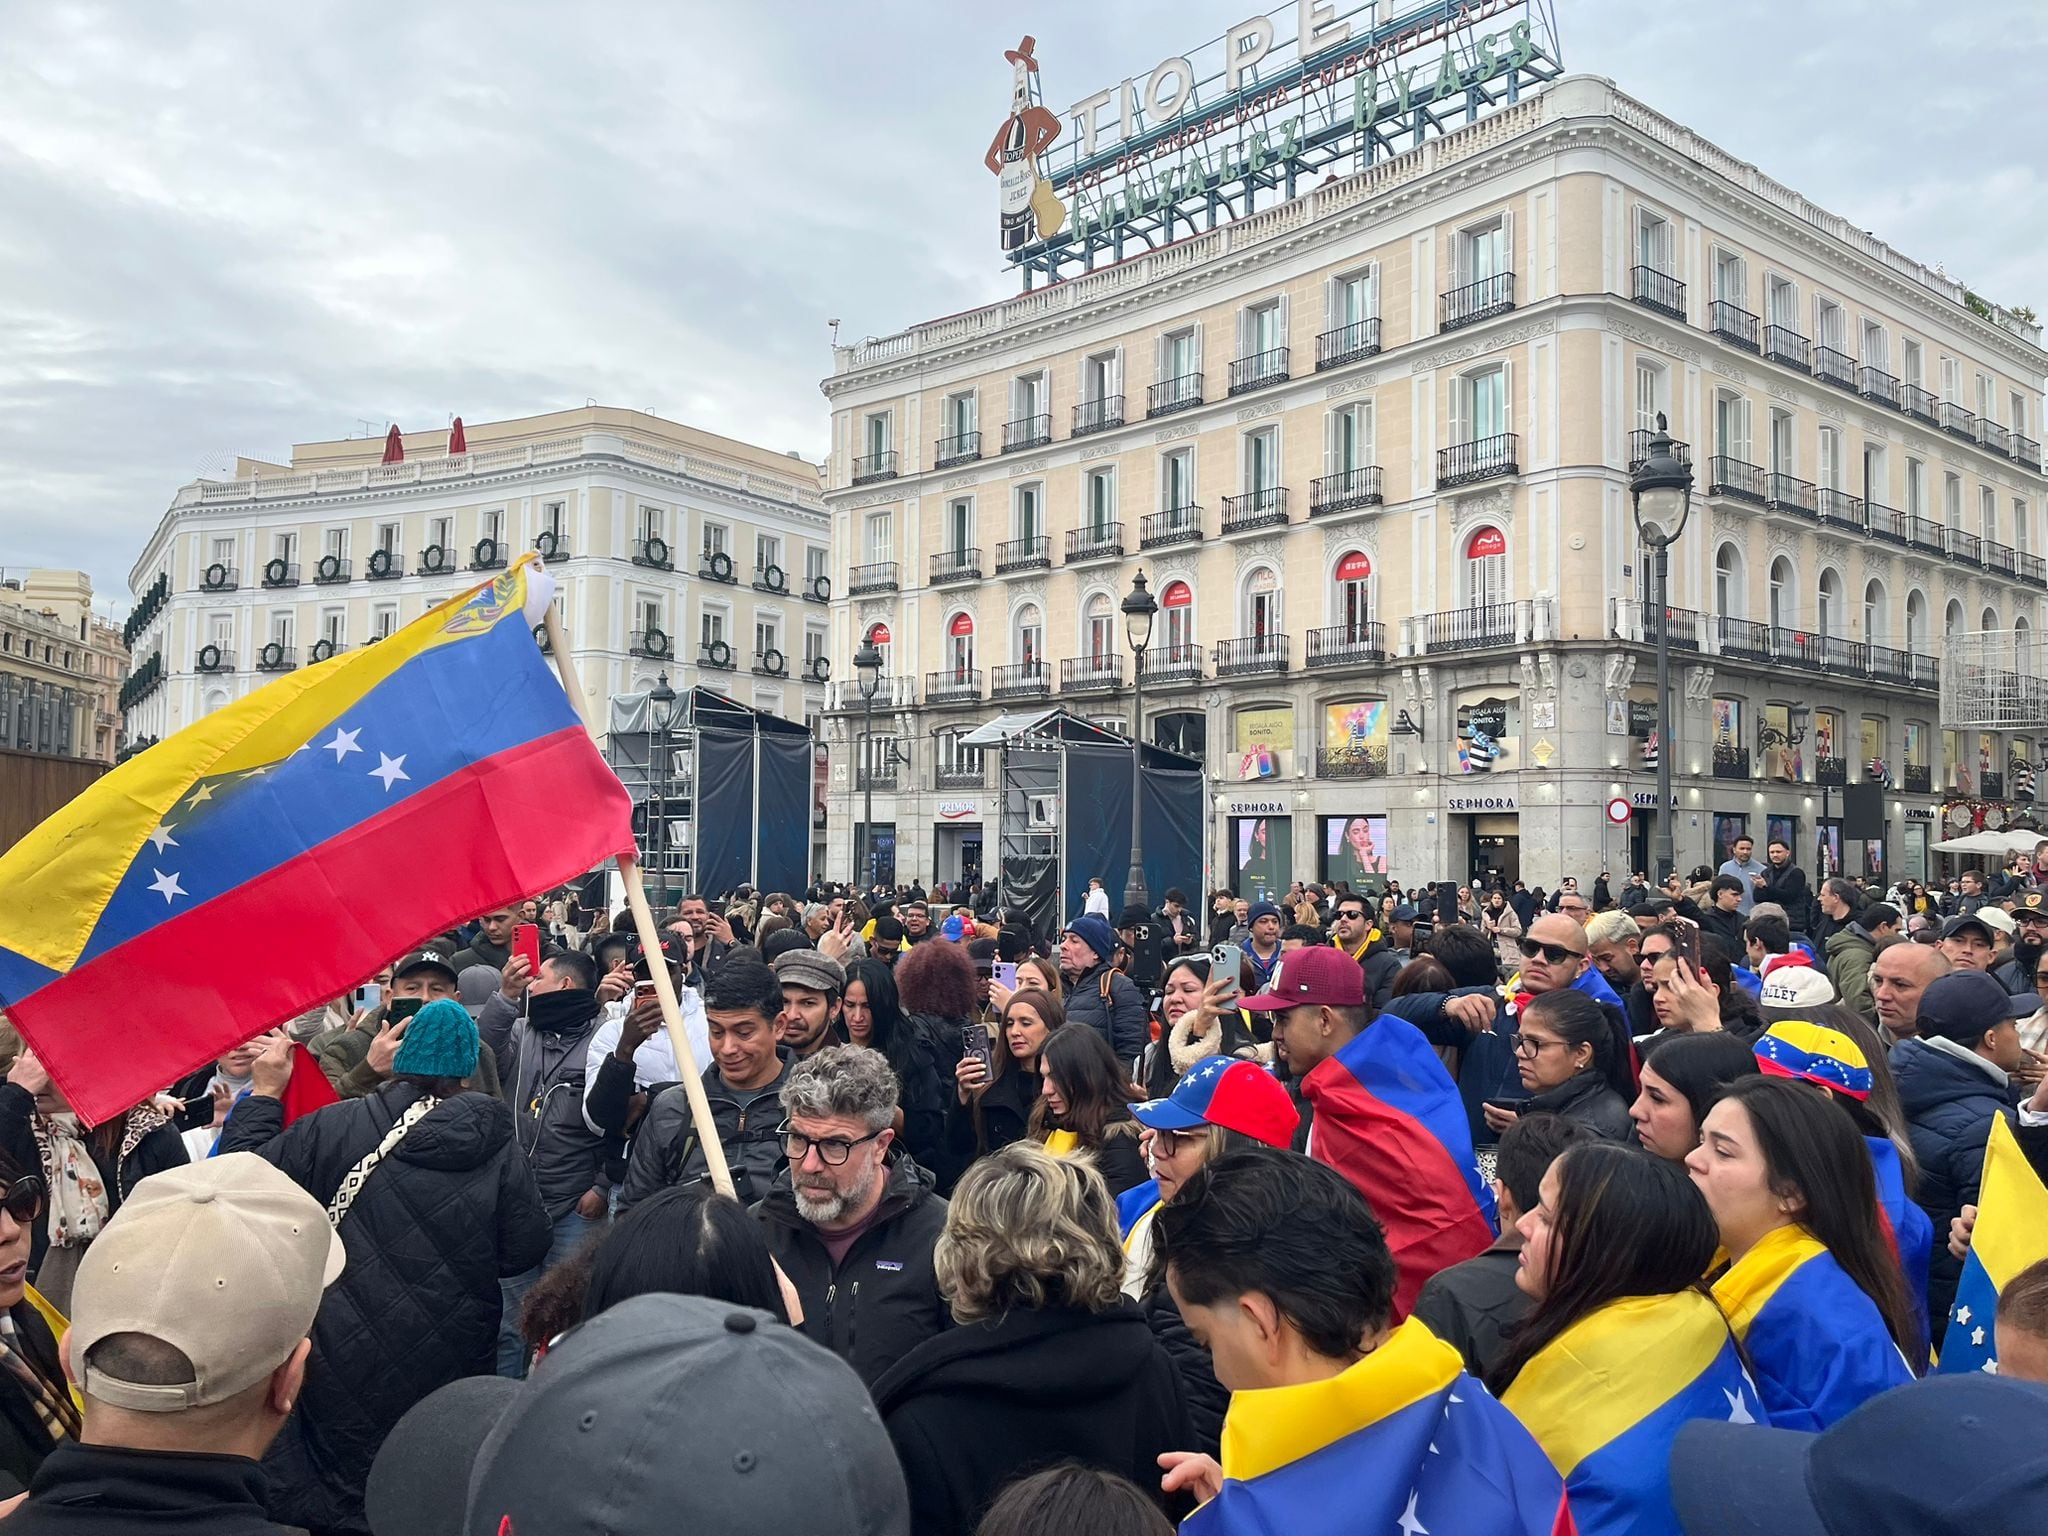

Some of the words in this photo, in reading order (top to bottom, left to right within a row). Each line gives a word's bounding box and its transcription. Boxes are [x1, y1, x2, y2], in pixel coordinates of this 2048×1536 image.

[1070, 56, 1192, 156] TIO
[1070, 114, 1300, 242] GONZALEZ
[1353, 19, 1532, 132] BYASS
[1066, 167, 1109, 196] SOL
[1116, 149, 1146, 176] DE
[1153, 84, 1290, 160] ANDALUCIA
[939, 801, 975, 812] PRIMOR
[1230, 802, 1284, 814] SEPHORA
[1449, 798, 1515, 810] SEPHORA
[1763, 988, 1797, 1002] ALLEY
